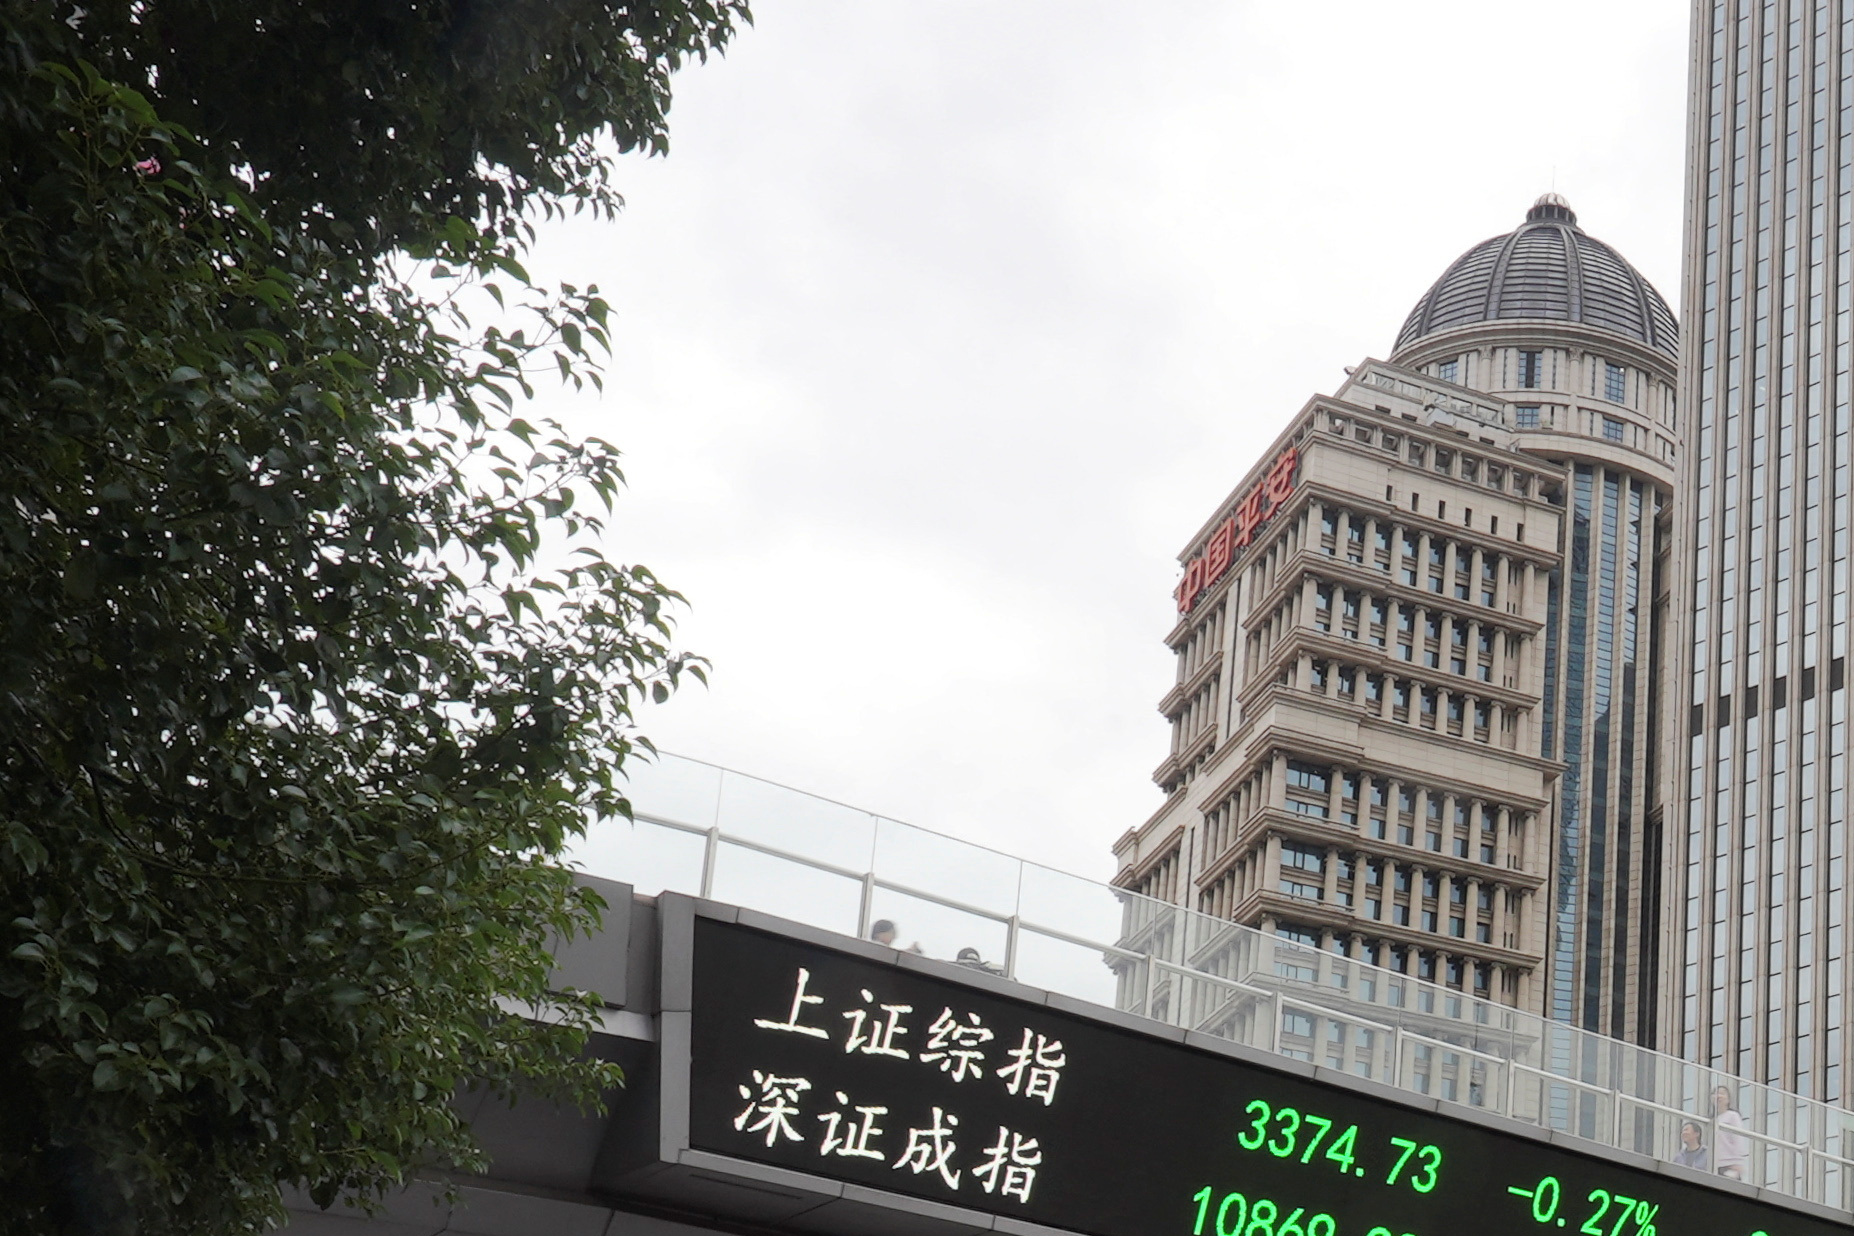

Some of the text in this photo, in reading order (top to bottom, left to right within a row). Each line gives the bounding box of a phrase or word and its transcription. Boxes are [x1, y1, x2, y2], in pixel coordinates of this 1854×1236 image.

[1177, 447, 1298, 614] 中国平安
[733, 1069, 1046, 1203] 深证成指
[754, 967, 1067, 1106] 上证综指
[1237, 1100, 1443, 1193] 3374.73
